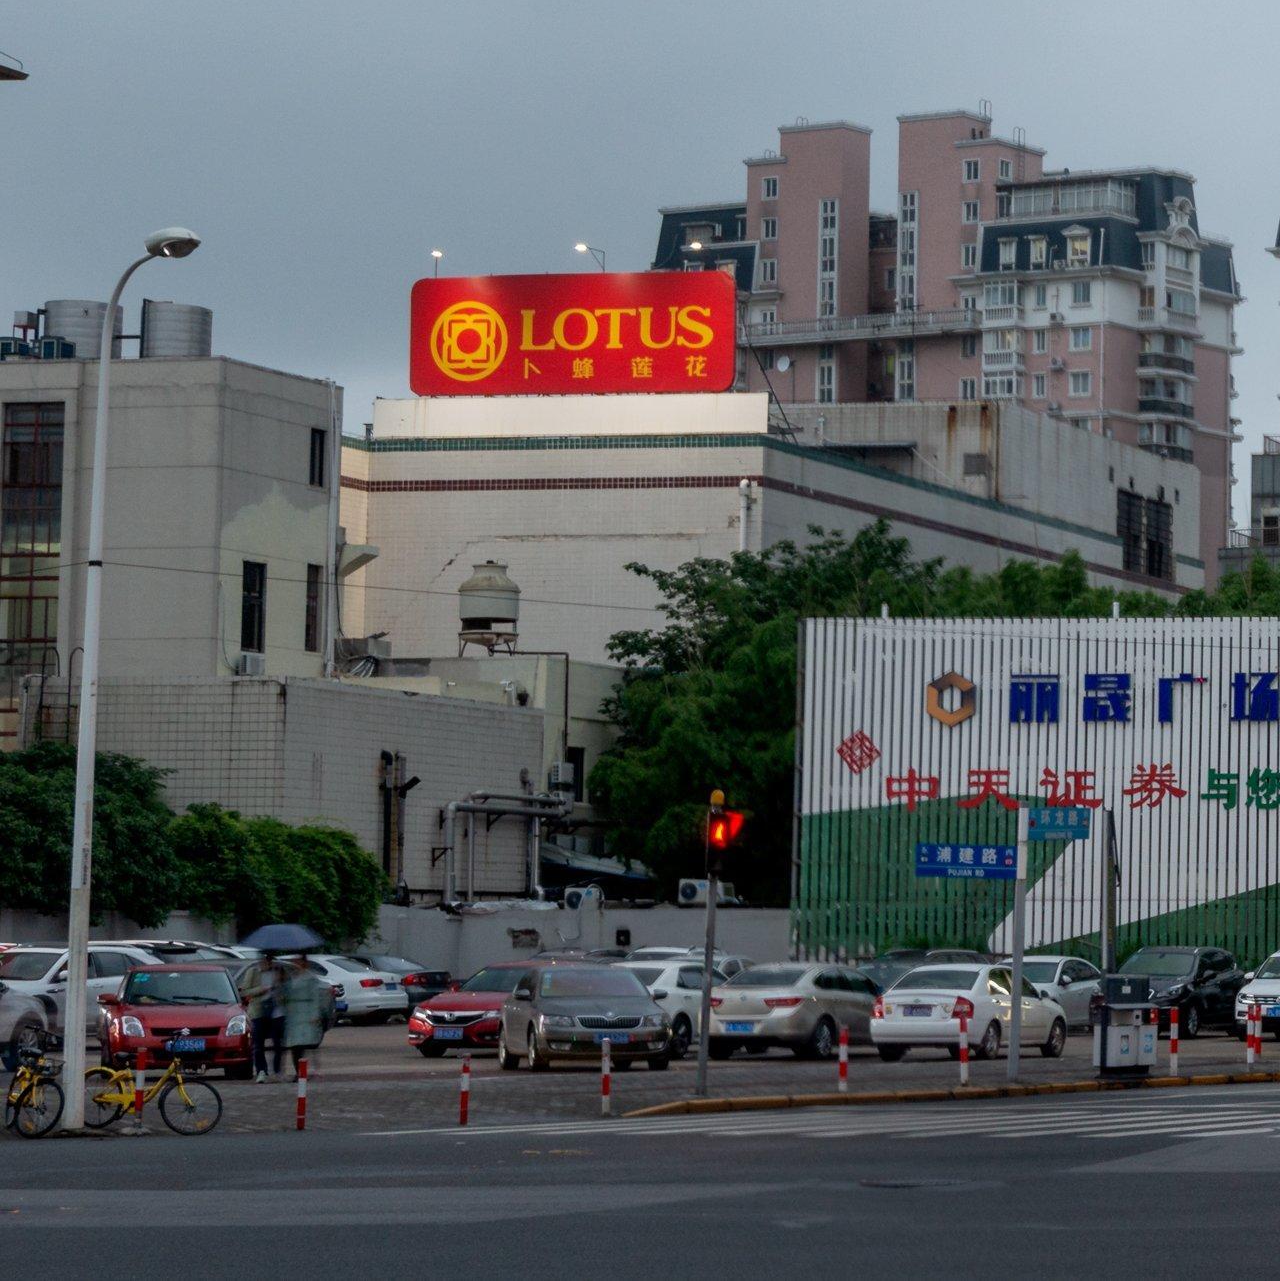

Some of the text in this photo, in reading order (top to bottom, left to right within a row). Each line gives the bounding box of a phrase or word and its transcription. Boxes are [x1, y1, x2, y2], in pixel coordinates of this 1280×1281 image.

[519, 305, 714, 351] LOTUS
[523, 355, 708, 379] 卜蜂莲花
[1009, 672, 1280, 723] 丽晟广场
[886, 763, 1188, 812] 中天证券
[937, 846, 998, 865] 浦建路
[948, 869, 985, 877] PUJIAN RD
